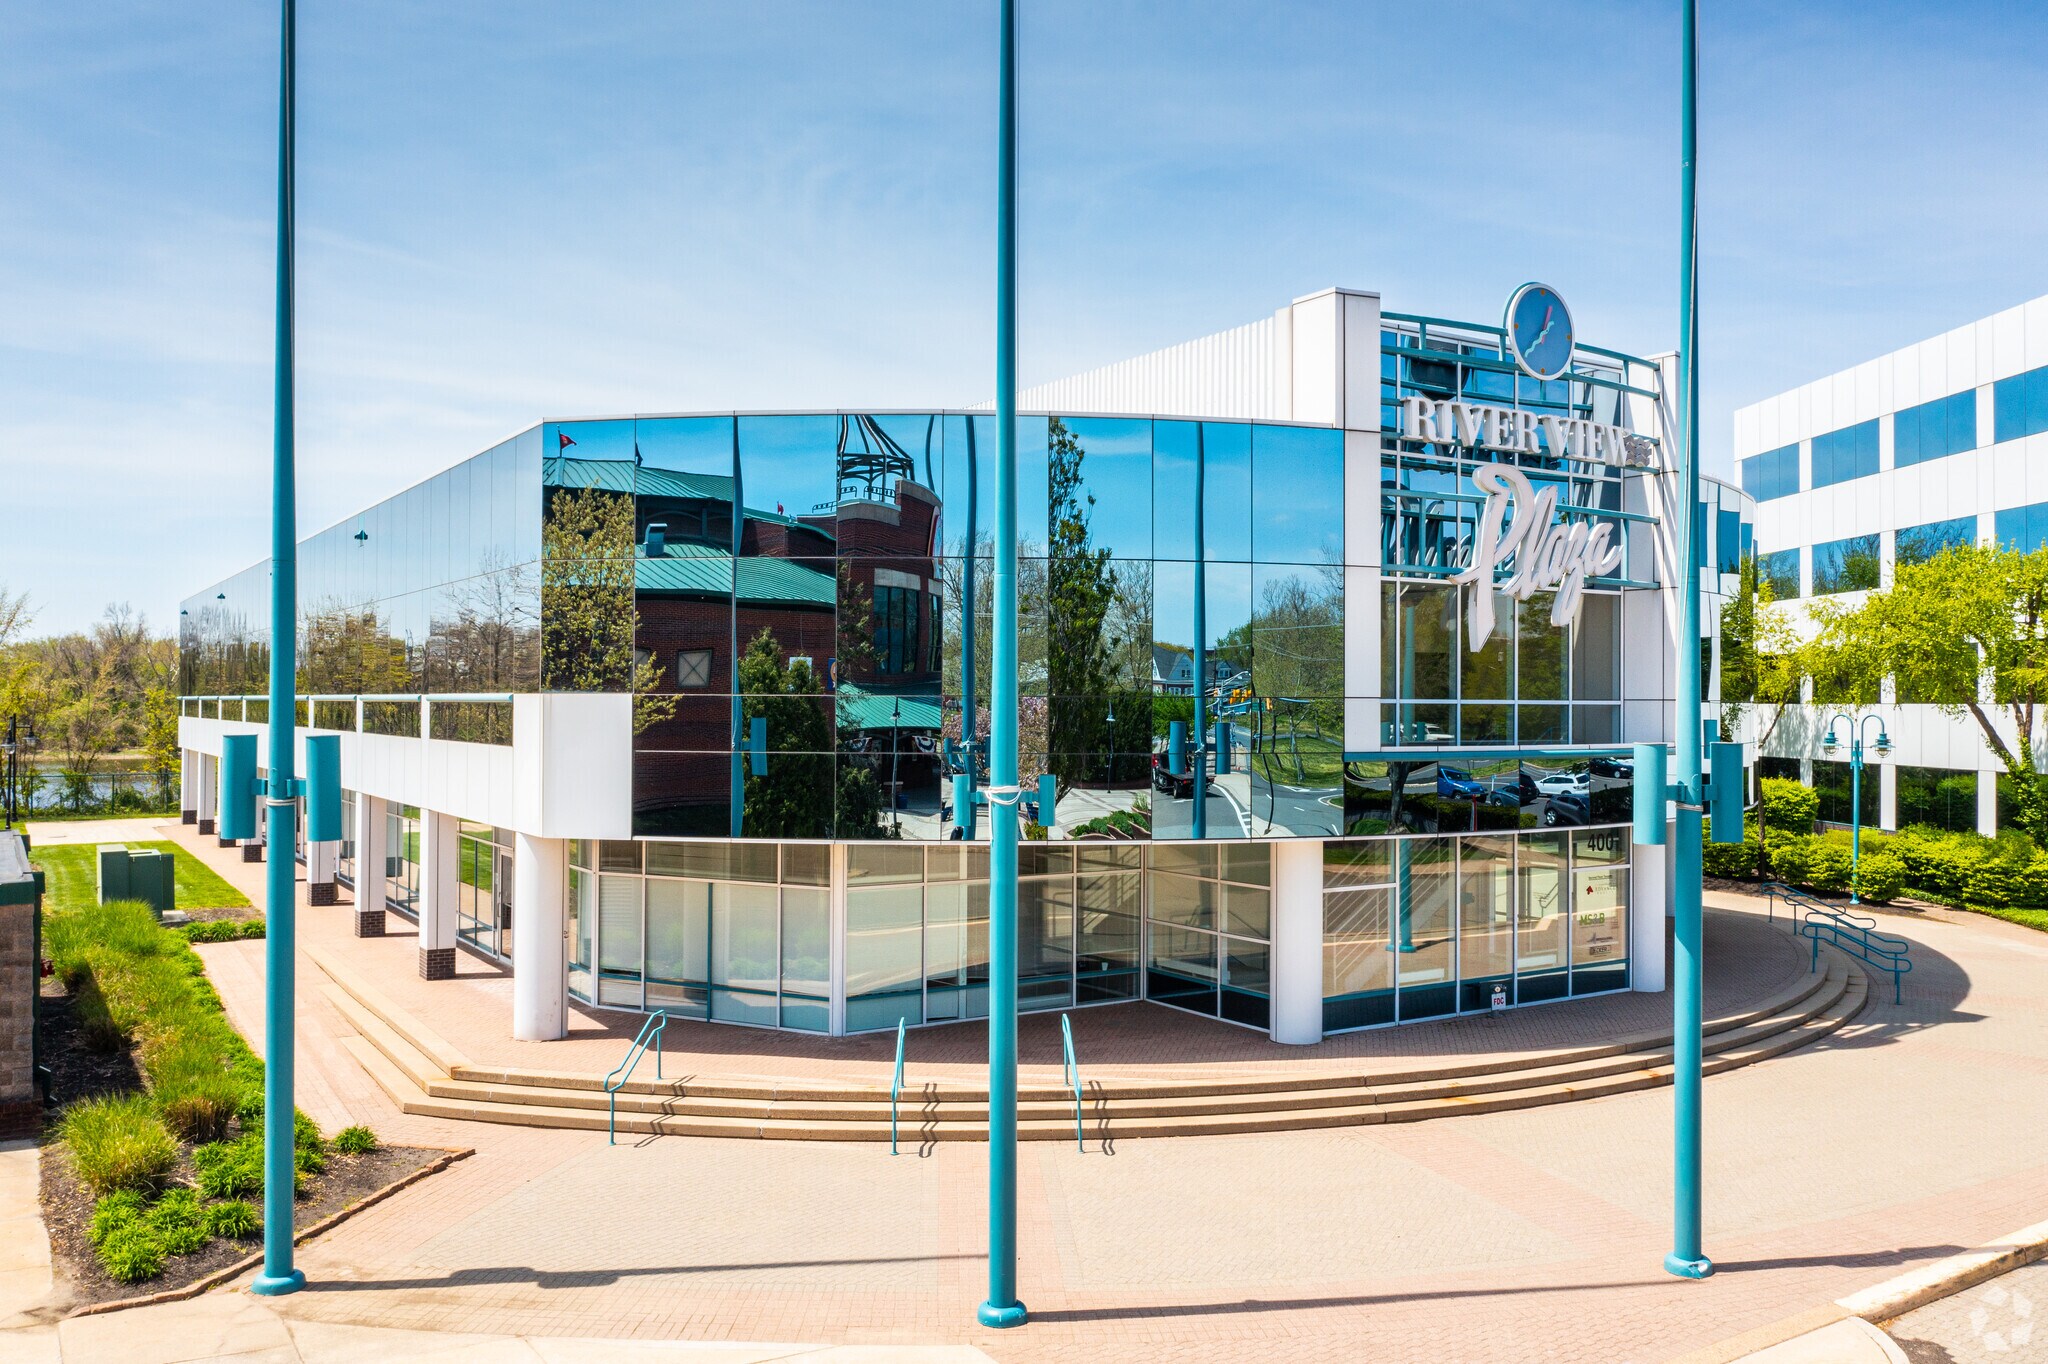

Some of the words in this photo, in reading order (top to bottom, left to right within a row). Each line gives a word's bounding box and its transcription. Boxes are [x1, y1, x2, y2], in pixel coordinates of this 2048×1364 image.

[1446, 463, 1624, 653] Plaza
[1587, 832, 1614, 851] 400
[1493, 997, 1504, 1005] FDC
